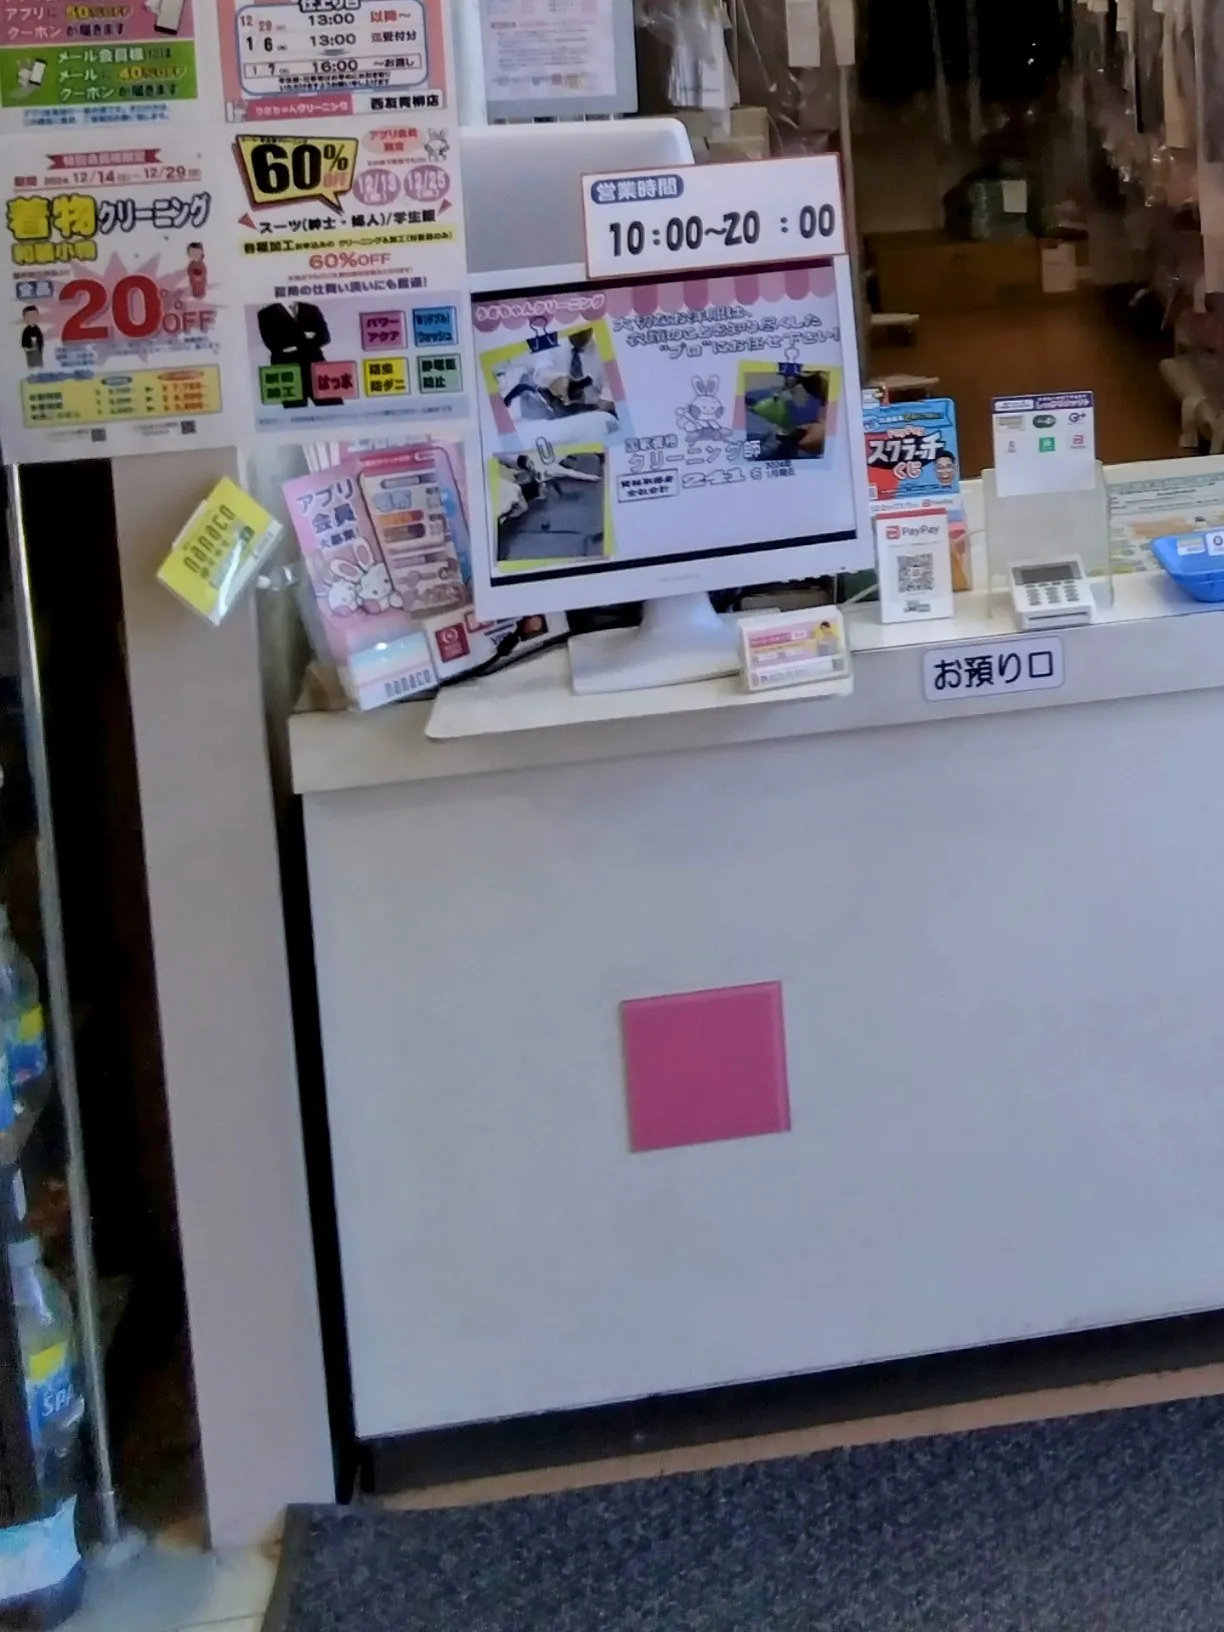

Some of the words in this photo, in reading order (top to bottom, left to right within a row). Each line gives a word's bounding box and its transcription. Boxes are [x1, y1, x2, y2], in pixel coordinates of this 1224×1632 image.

[308, 13, 356, 27] 13:00
[309, 33, 357, 48] 13:00
[311, 59, 359, 74] 16:00
[250, 143, 351, 195] 60%
[595, 177, 679, 202] 営業時間
[308, 251, 393, 270] 60%OFF
[161, 309, 217, 335] OFF
[866, 433, 946, 466] スクラッチ
[892, 460, 923, 479] くじ
[295, 478, 355, 514] アプリ
[901, 524, 941, 539] PayPay
[932, 648, 1055, 692] お預り口
